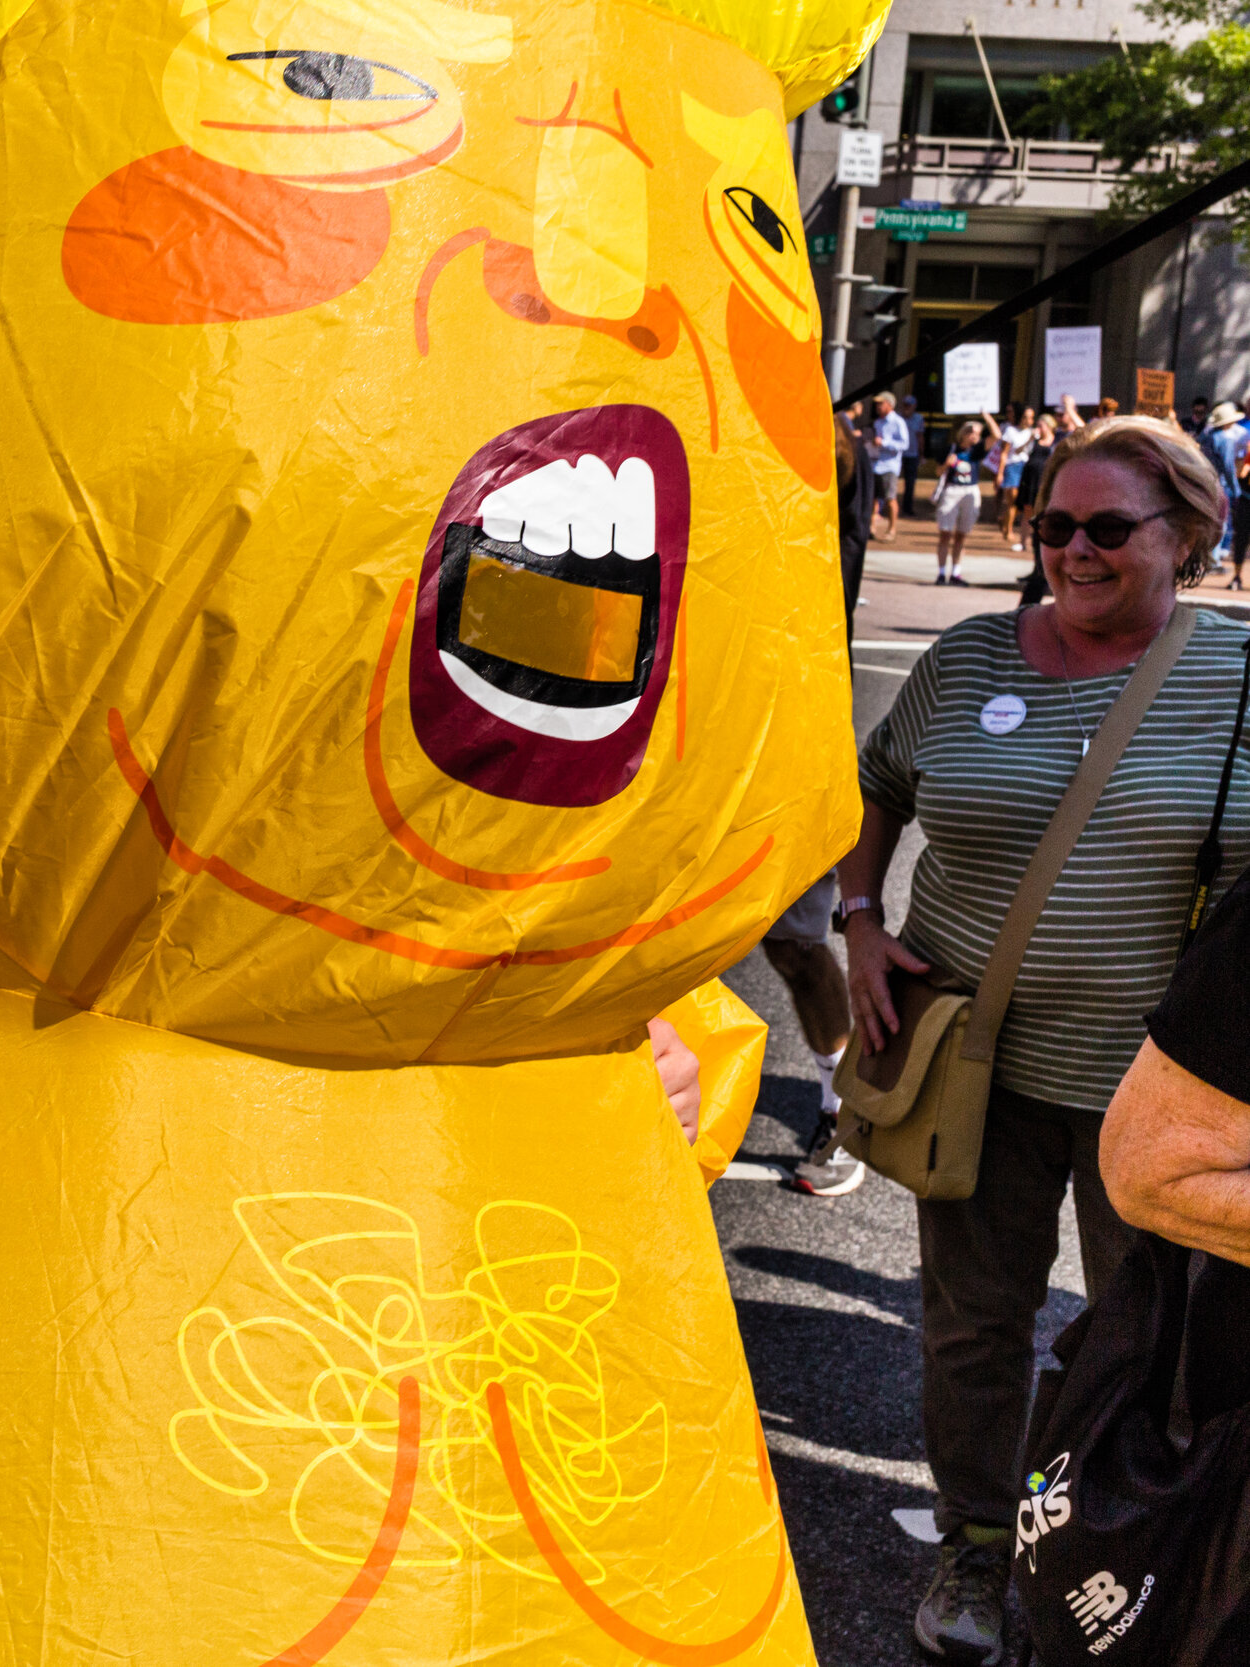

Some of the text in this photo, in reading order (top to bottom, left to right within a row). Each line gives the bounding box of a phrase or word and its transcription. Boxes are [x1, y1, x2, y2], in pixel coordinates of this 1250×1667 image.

[876, 209, 954, 230] Pennsylvania
[1087, 1574, 1155, 1656] new balance
